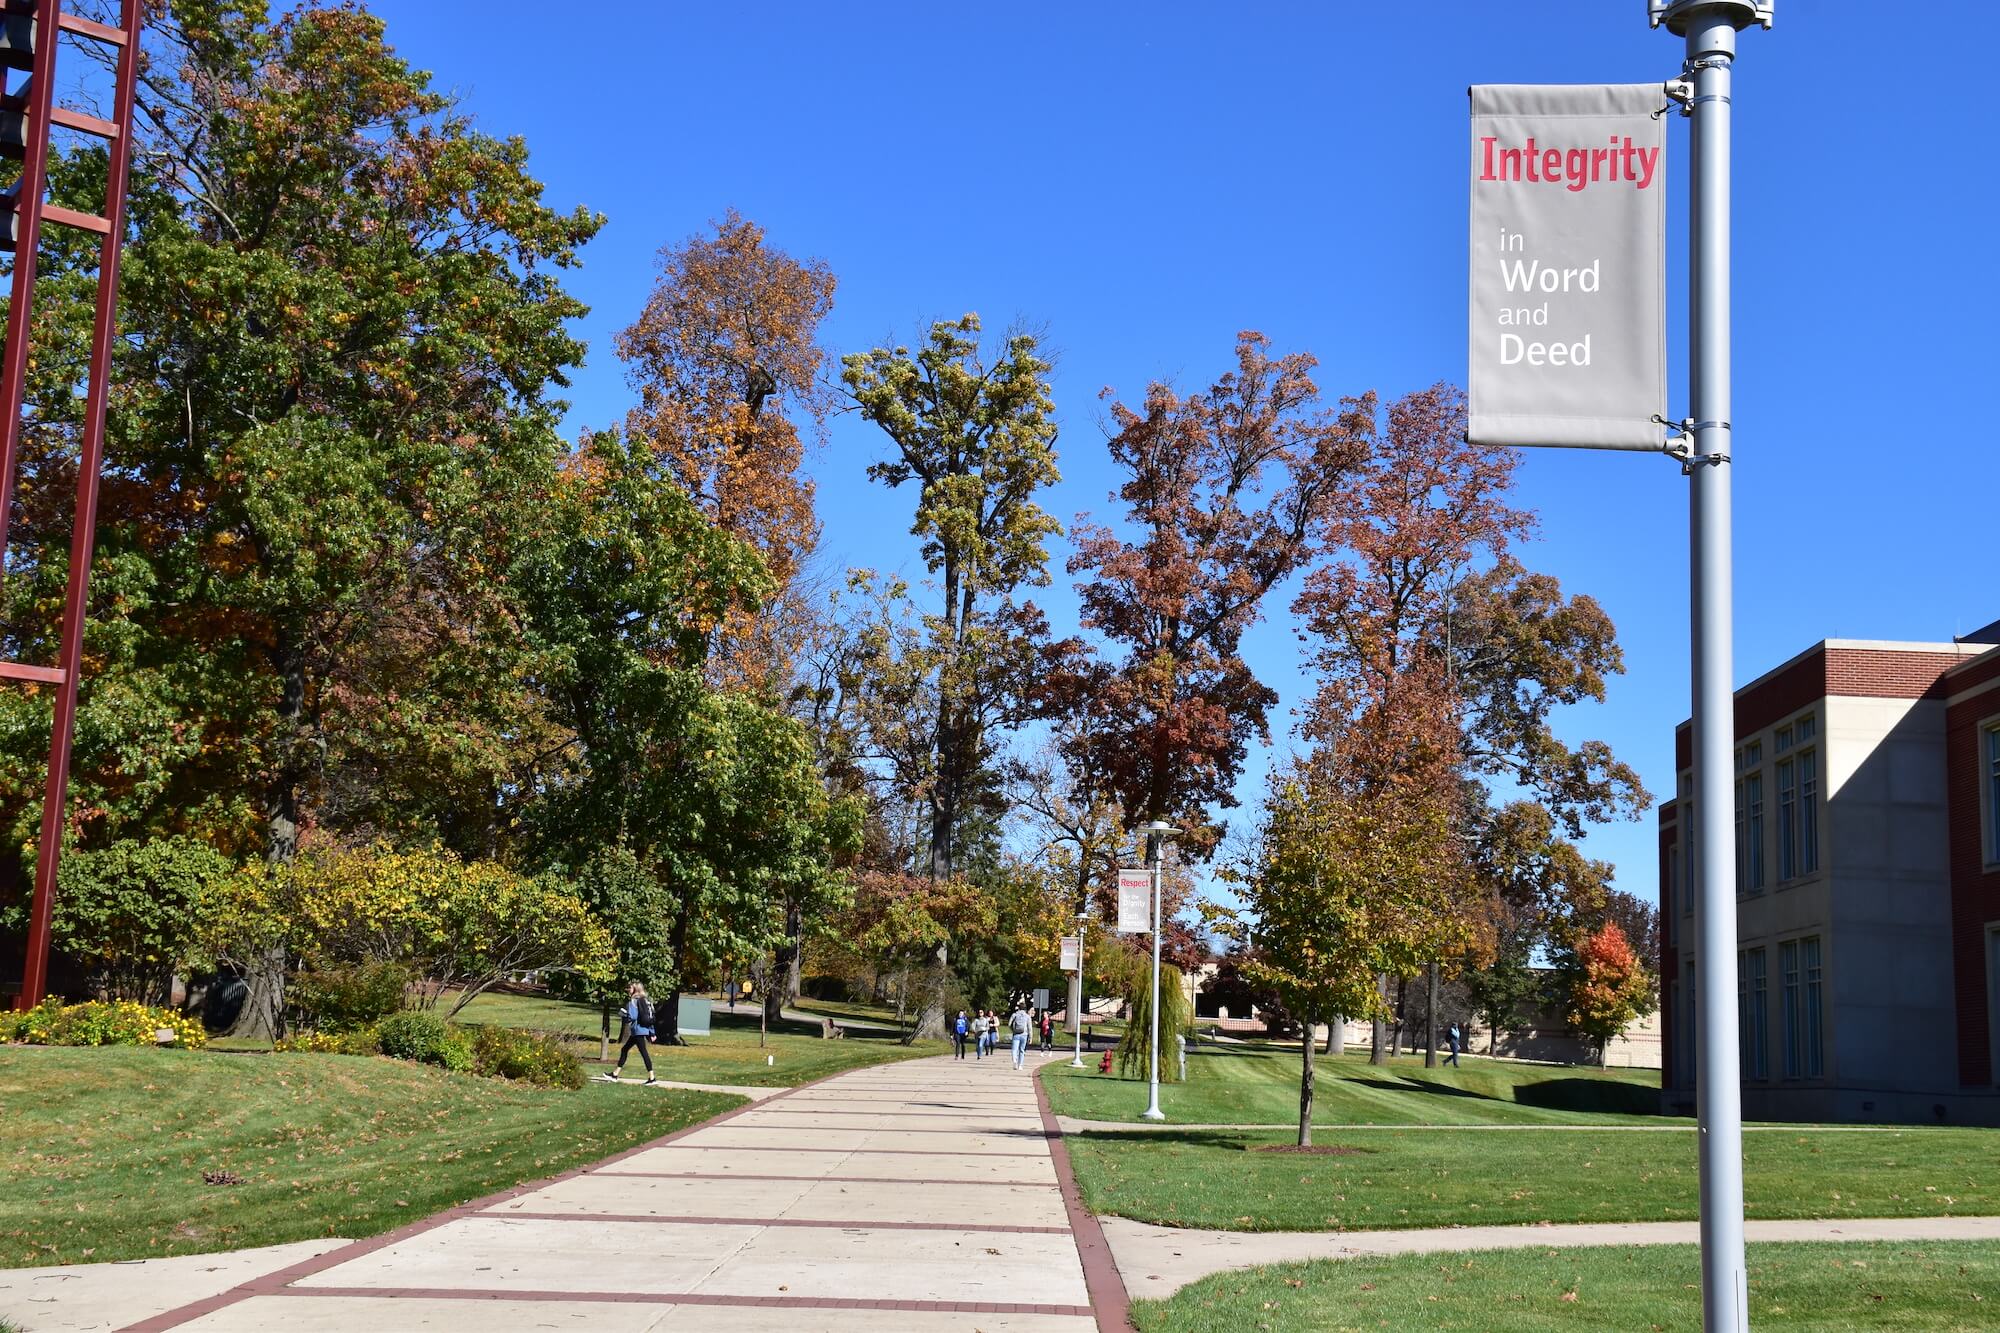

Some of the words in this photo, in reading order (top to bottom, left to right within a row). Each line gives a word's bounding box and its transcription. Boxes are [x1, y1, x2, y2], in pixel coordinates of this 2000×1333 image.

[1480, 136, 1659, 191] Integrity
[1500, 228, 1524, 251] in
[1500, 259, 1599, 292] Word
[1498, 303, 1548, 325] and
[1500, 334, 1591, 365] Deed
[1120, 878, 1149, 888] Respect
